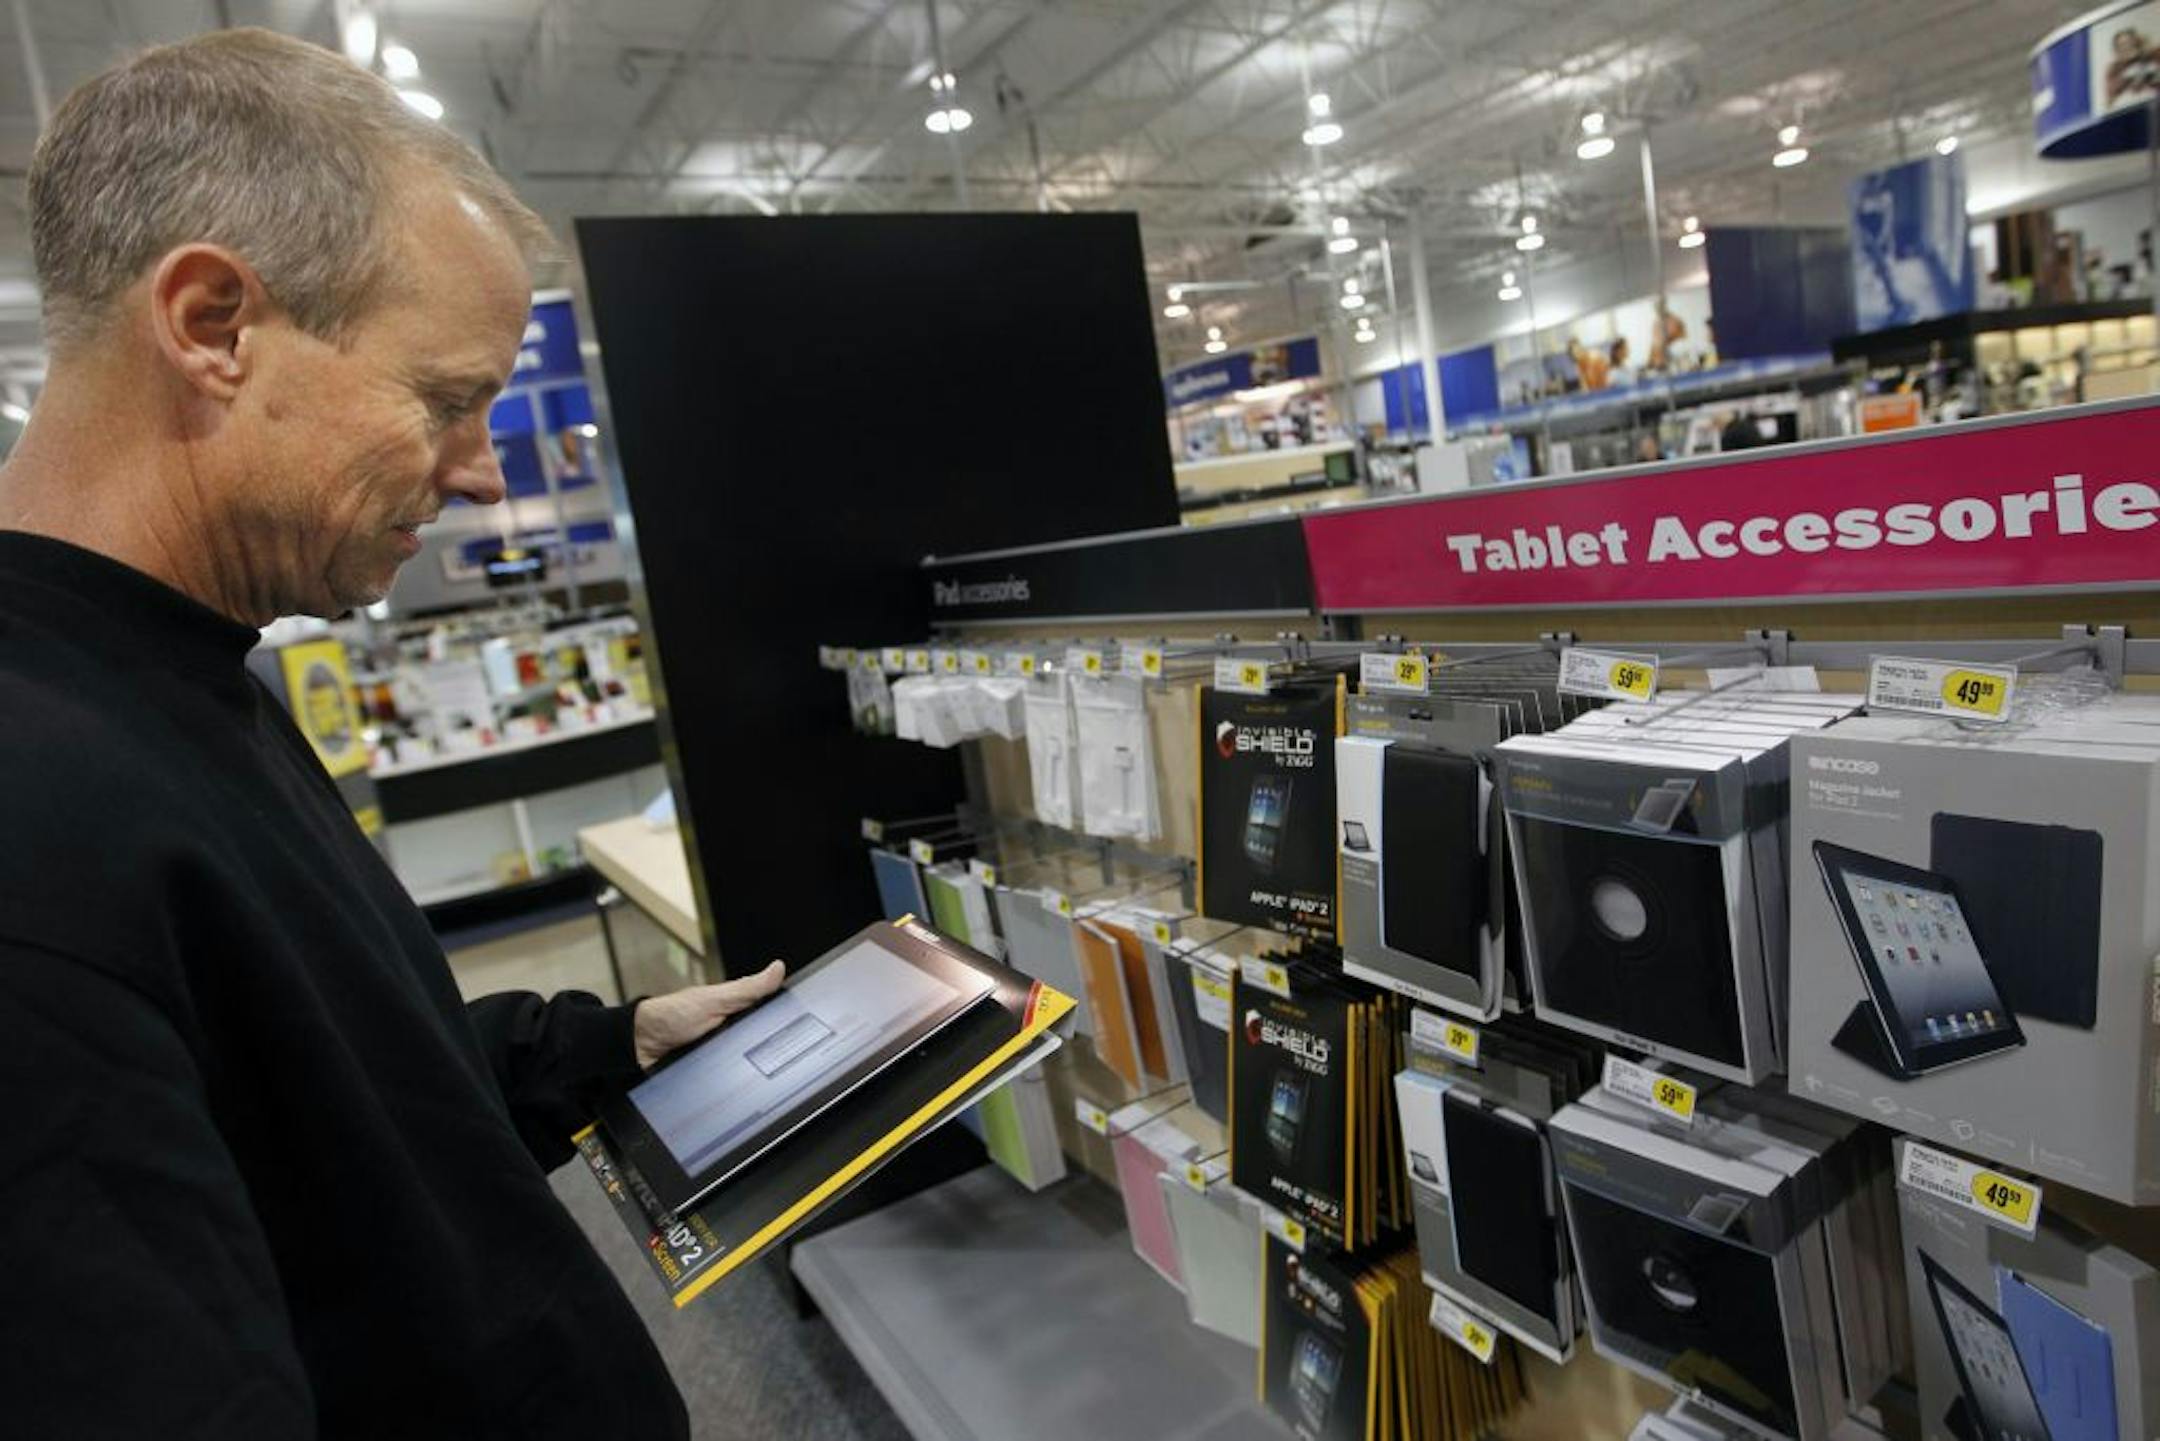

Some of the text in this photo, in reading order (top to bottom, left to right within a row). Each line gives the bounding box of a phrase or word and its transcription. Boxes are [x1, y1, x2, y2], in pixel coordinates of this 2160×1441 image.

[1447, 474, 2160, 573] Tablet Accessorie
[1235, 735, 1314, 754] SHIELD
[1261, 1026, 1329, 1063] SHIELD
[680, 1245, 704, 1267] 2
